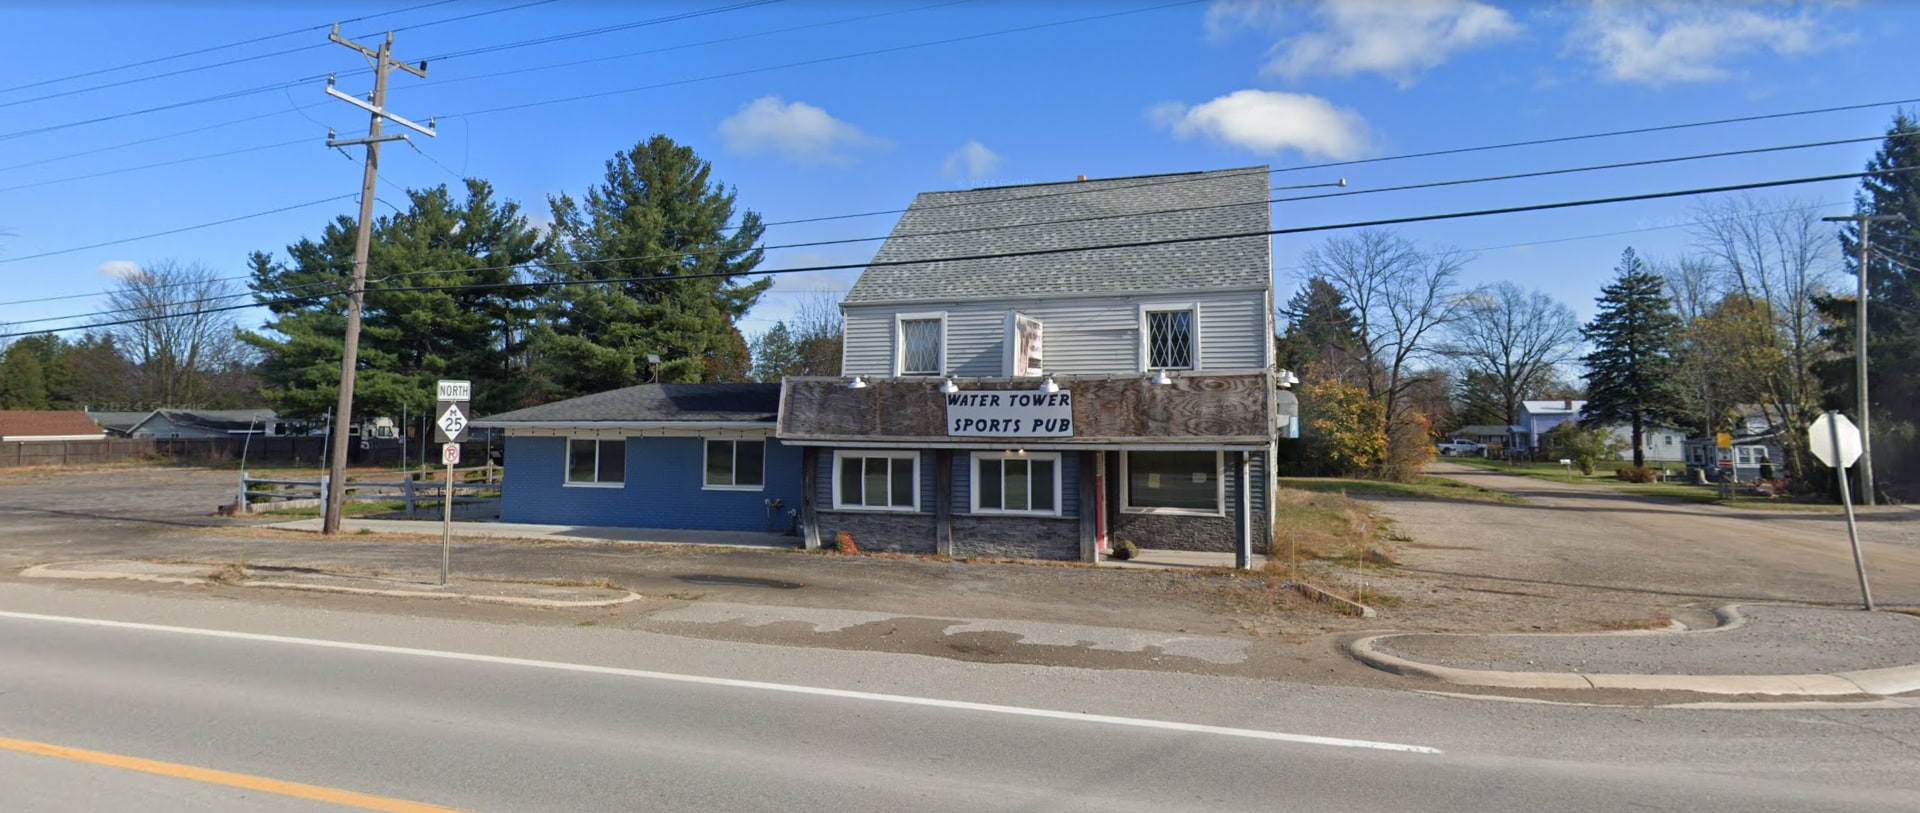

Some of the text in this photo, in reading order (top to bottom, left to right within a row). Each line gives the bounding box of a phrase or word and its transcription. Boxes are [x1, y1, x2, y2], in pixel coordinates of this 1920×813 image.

[440, 385, 468, 397] NORTH
[948, 394, 1070, 407] WATER TOWER
[445, 418, 462, 432] 25
[954, 419, 1070, 432] SPORTS PUB
